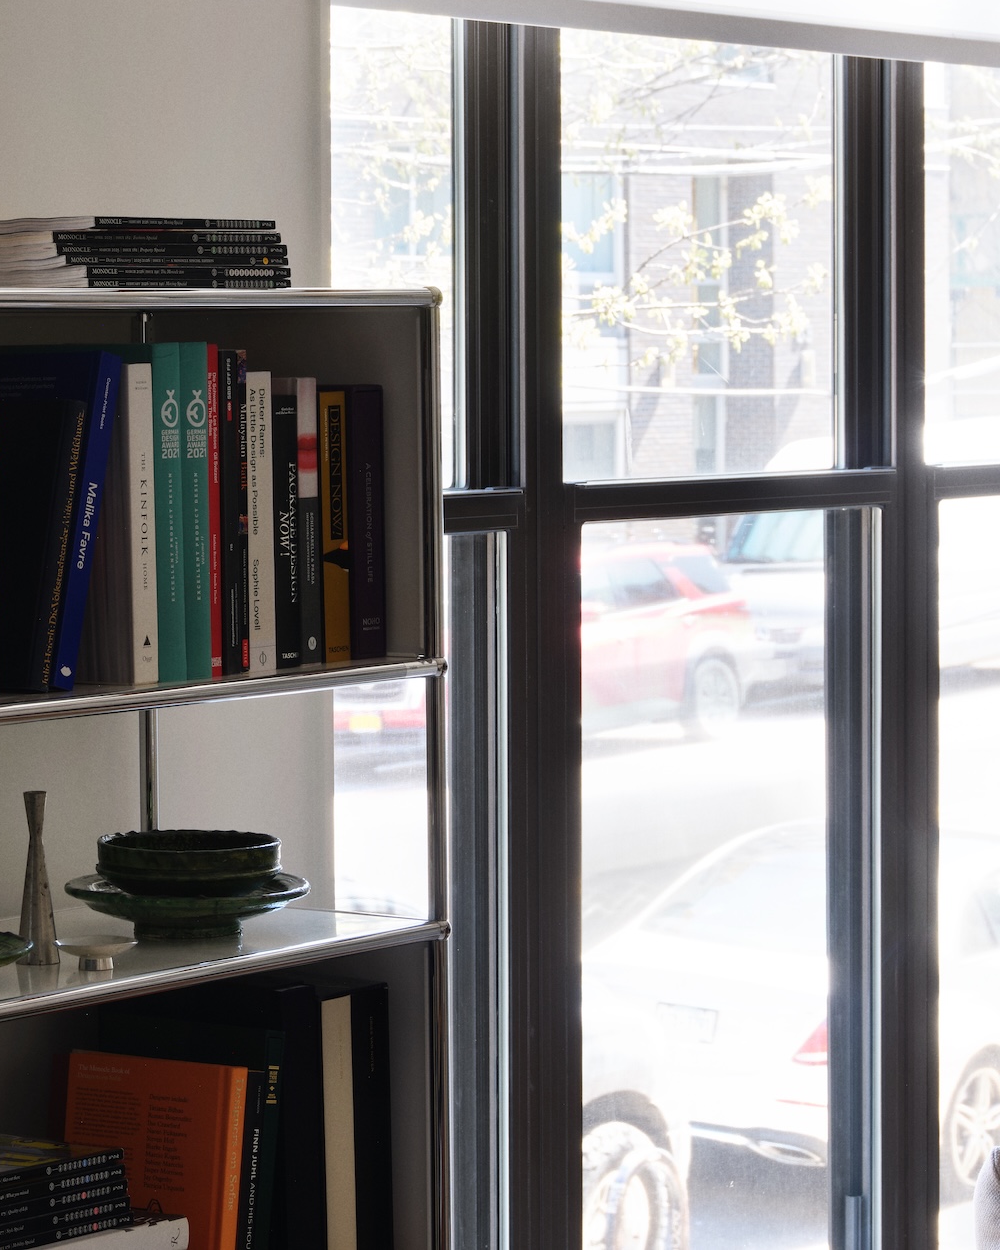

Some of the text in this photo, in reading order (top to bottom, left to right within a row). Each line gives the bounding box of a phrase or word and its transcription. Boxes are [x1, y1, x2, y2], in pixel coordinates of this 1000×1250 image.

[250, 388, 256, 402] As
[238, 403, 247, 458] Malaysian
[161, 449, 180, 459] 2021
[187, 449, 206, 459] 2021
[330, 408, 342, 535] DESIGN NOW!
[252, 475, 256, 487] as
[289, 462, 297, 539] PACKAGE
[77, 482, 98, 570] Malika Favre
[280, 511, 290, 557] NOW!
[362, 617, 380, 625] NOHO
[228, 1079, 244, 1211] Designers on Sofas
